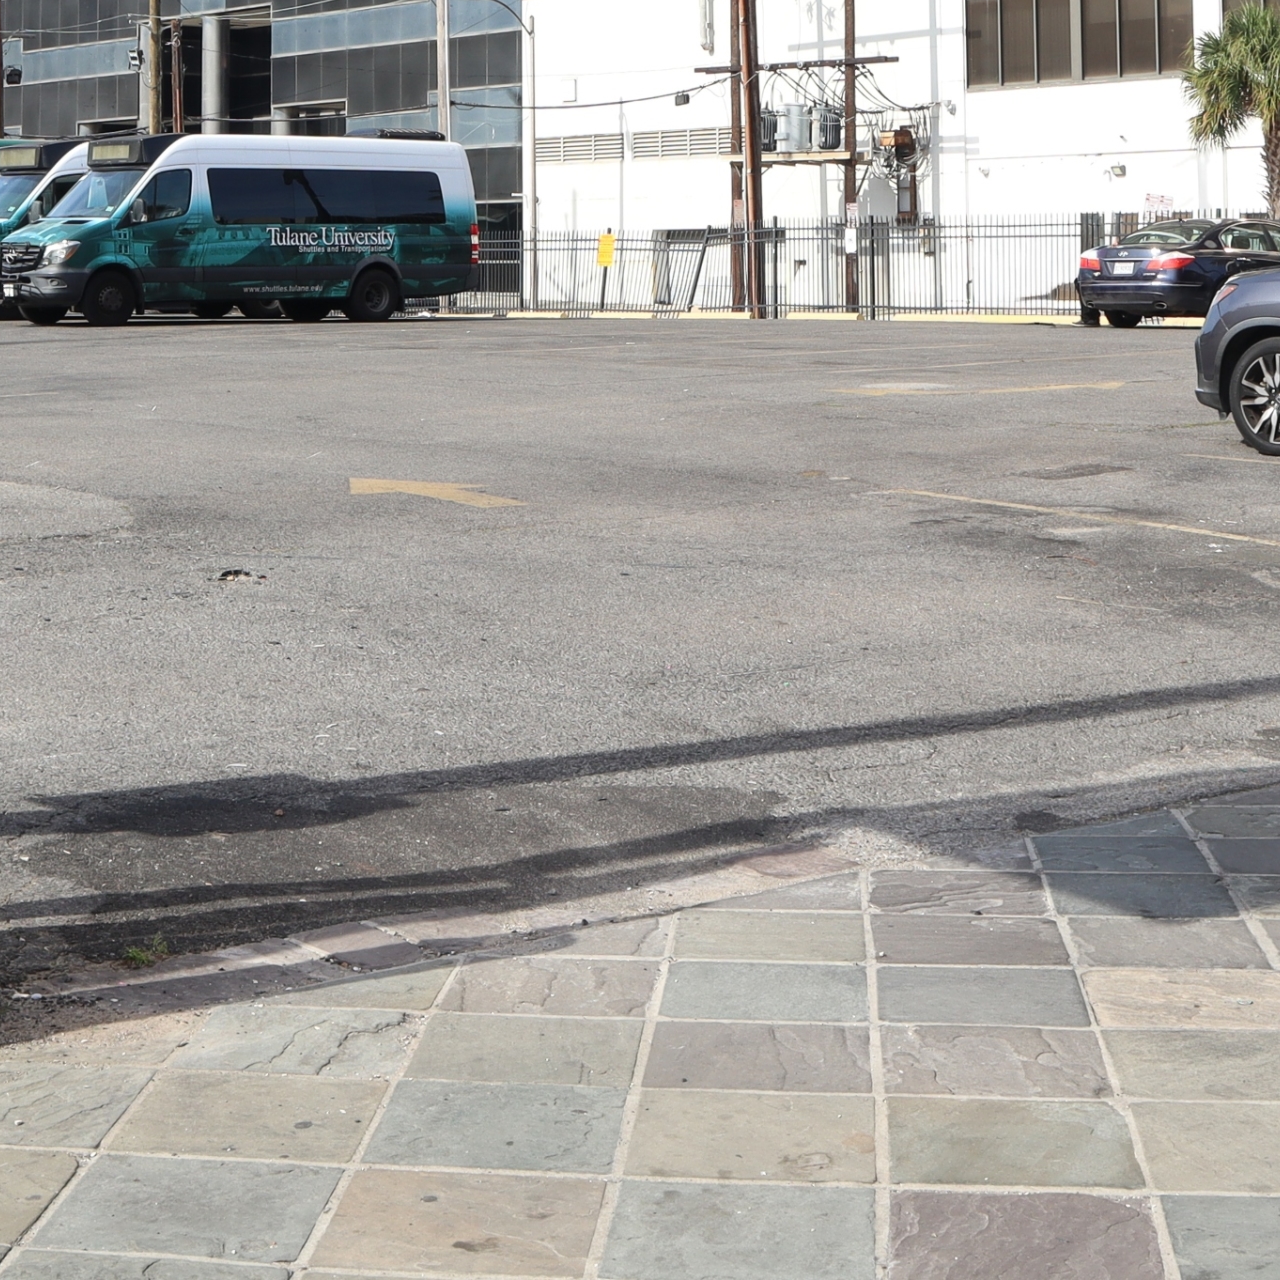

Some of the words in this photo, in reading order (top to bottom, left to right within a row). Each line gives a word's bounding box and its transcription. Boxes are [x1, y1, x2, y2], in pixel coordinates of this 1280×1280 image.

[266, 227, 318, 246] Tulane
[321, 226, 396, 250] University
[298, 245, 325, 253] Shuttles
[326, 245, 339, 253] and
[341, 245, 387, 254] Transportation
[242, 284, 324, 293] www.shuttles.tulane.edu
